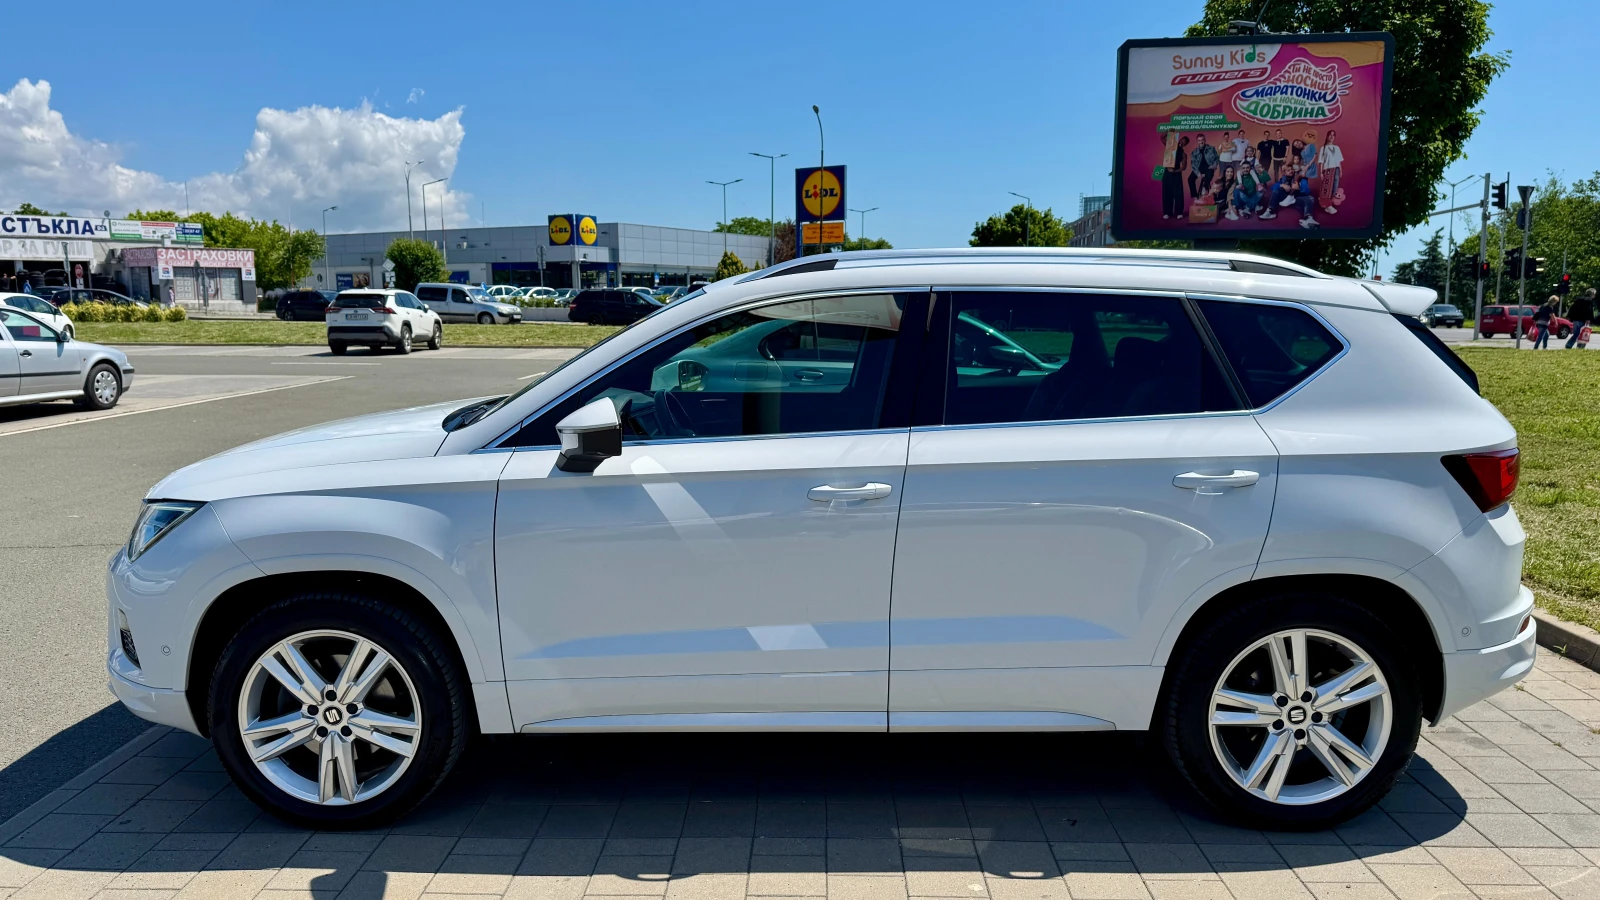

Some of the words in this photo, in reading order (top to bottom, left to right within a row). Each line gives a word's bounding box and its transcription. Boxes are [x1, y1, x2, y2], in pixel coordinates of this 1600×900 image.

[1172, 54, 1224, 70] Sunny
[1230, 44, 1266, 66] Kids
[1174, 69, 1263, 84] runners
[1303, 65, 1312, 75] НЕ
[1313, 69, 1333, 82] ПРОСТО
[1240, 85, 1338, 103] МАРАТОНКИ
[1239, 100, 1328, 119] ДОБРИНА
[804, 184, 838, 200] LIDL
[1, 216, 95, 235] СТЪКЛА
[551, 225, 569, 234] LIDL
[18, 240, 38, 255] ЗА
[158, 249, 252, 261] ЗАСТРАХОВКИ
